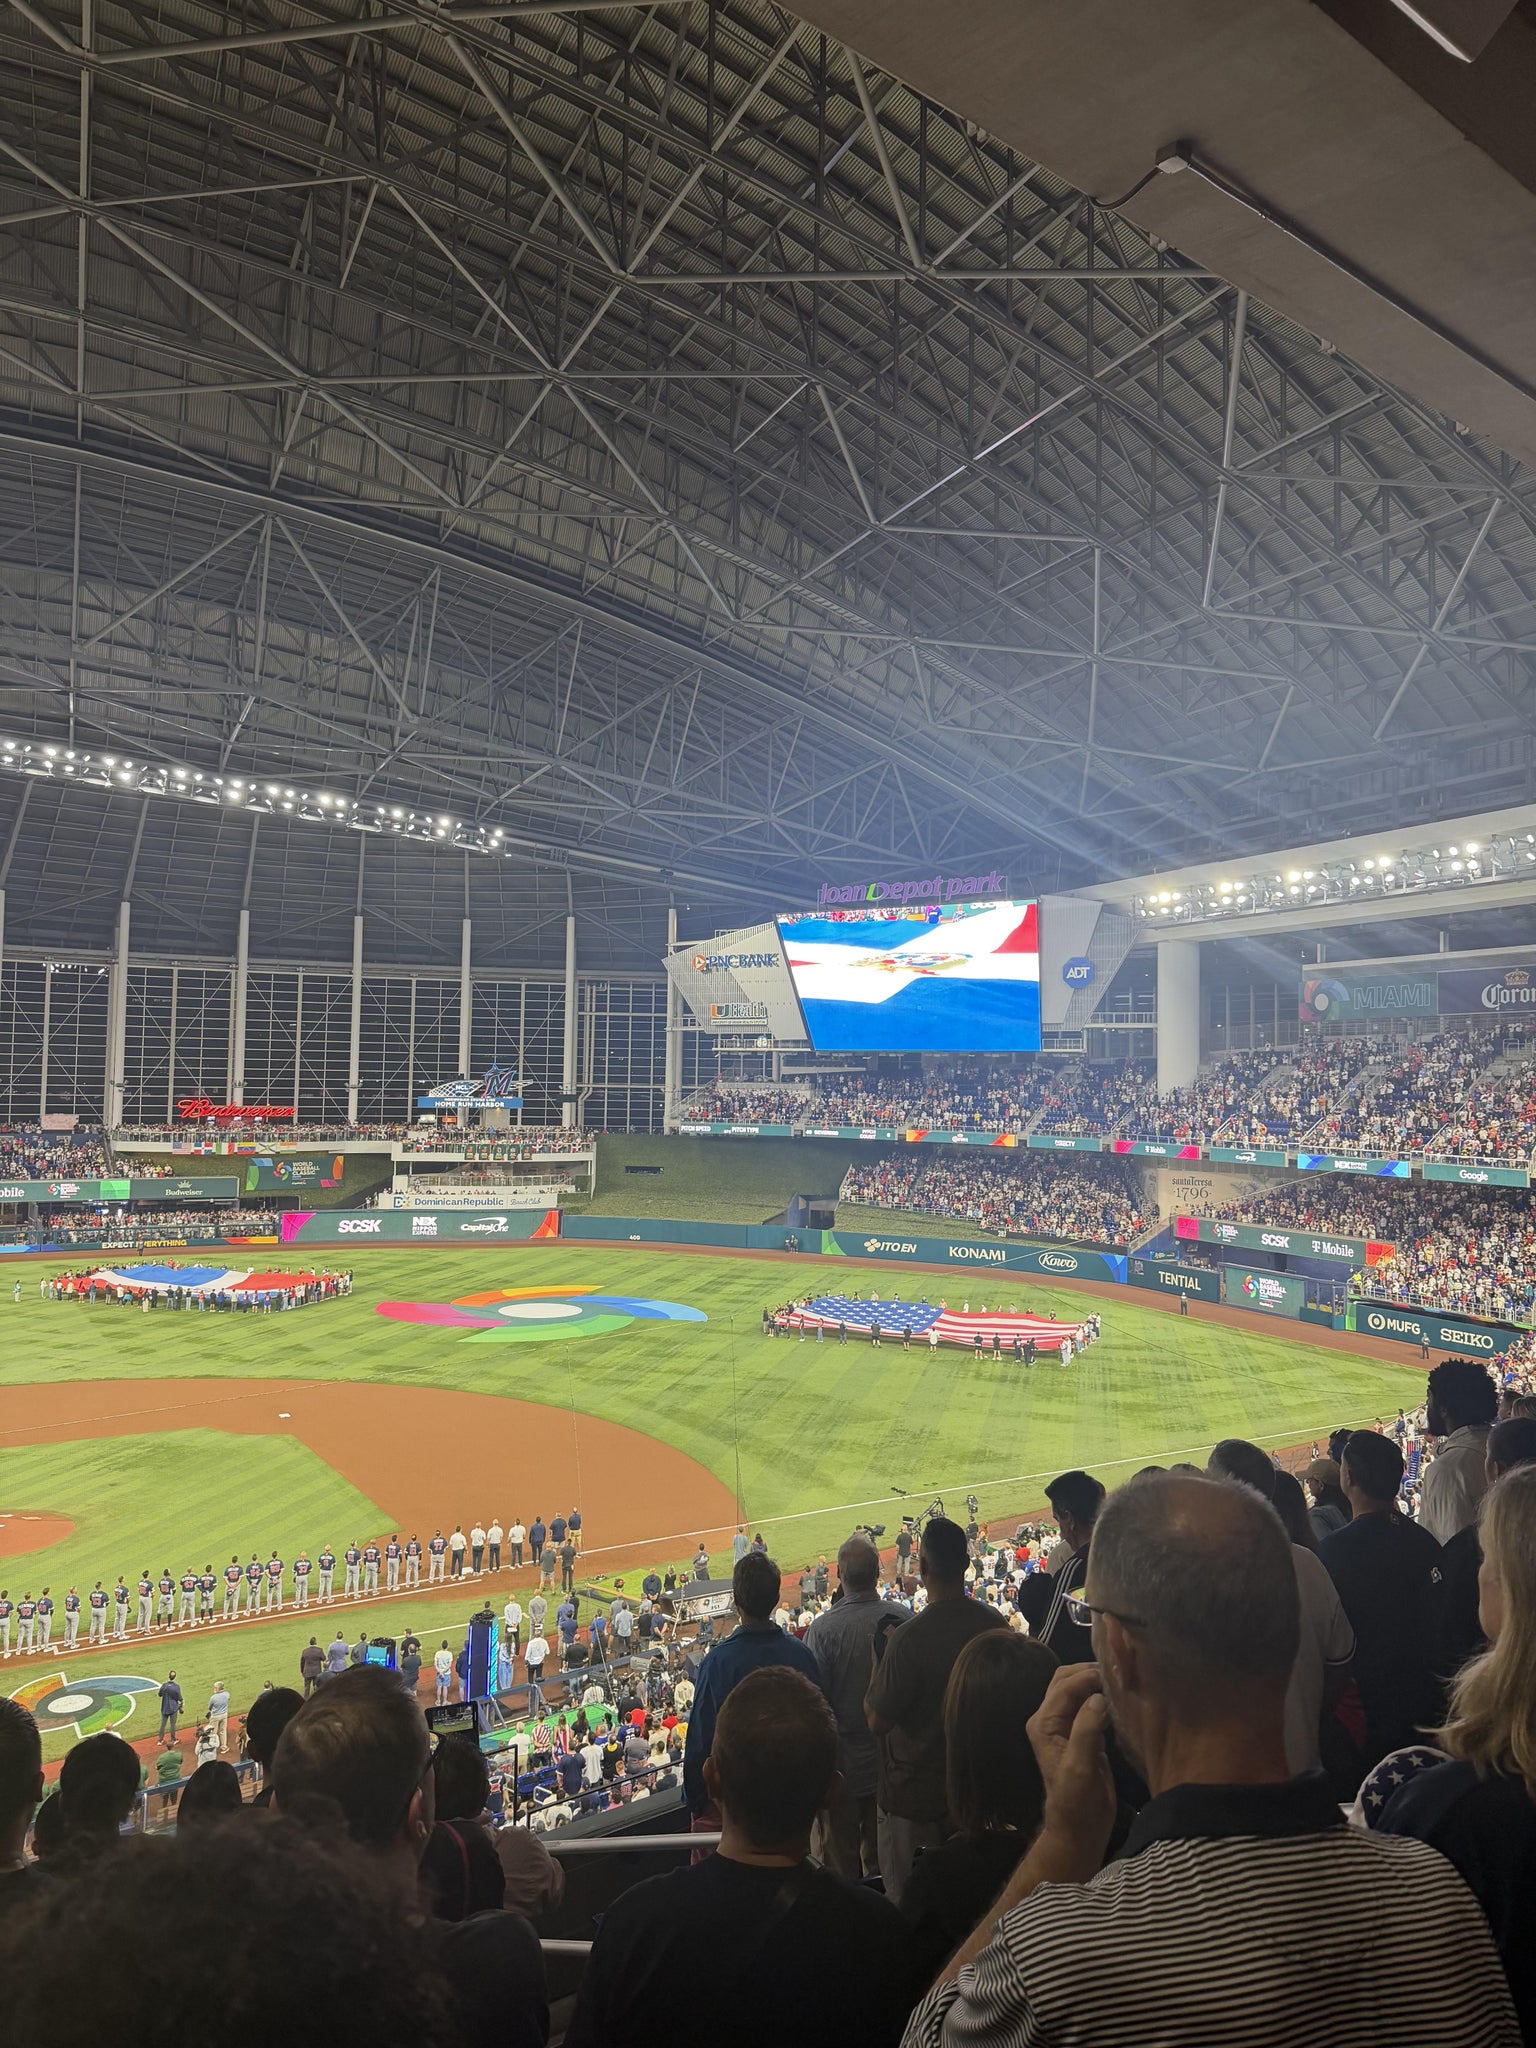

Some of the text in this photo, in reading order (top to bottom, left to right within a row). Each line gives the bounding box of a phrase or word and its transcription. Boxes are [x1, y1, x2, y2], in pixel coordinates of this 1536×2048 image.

[820, 871, 1005, 905] loanDepot park
[1066, 966, 1091, 979] ADT
[1354, 983, 1431, 1010] MIAMI
[177, 1099, 297, 1118] Budweiser
[1459, 1169, 1489, 1182] Google
[1175, 1187, 1210, 1201] 1796
[414, 1197, 463, 1206] Dominican
[464, 1197, 504, 1208] Republic
[338, 1219, 382, 1233] SCSK
[101, 1239, 187, 1249] EXPECT ERYTHING
[880, 1241, 917, 1254] ITO EN
[1261, 1233, 1290, 1249] SCSK
[949, 1246, 1006, 1261] KONAMI
[1322, 1241, 1354, 1258] Mobile
[1042, 1254, 1077, 1268] Kowa
[1158, 1270, 1202, 1291] TENTIAL
[1386, 1318, 1421, 1335] MUFG
[1440, 1328, 1494, 1349] SEIKO
